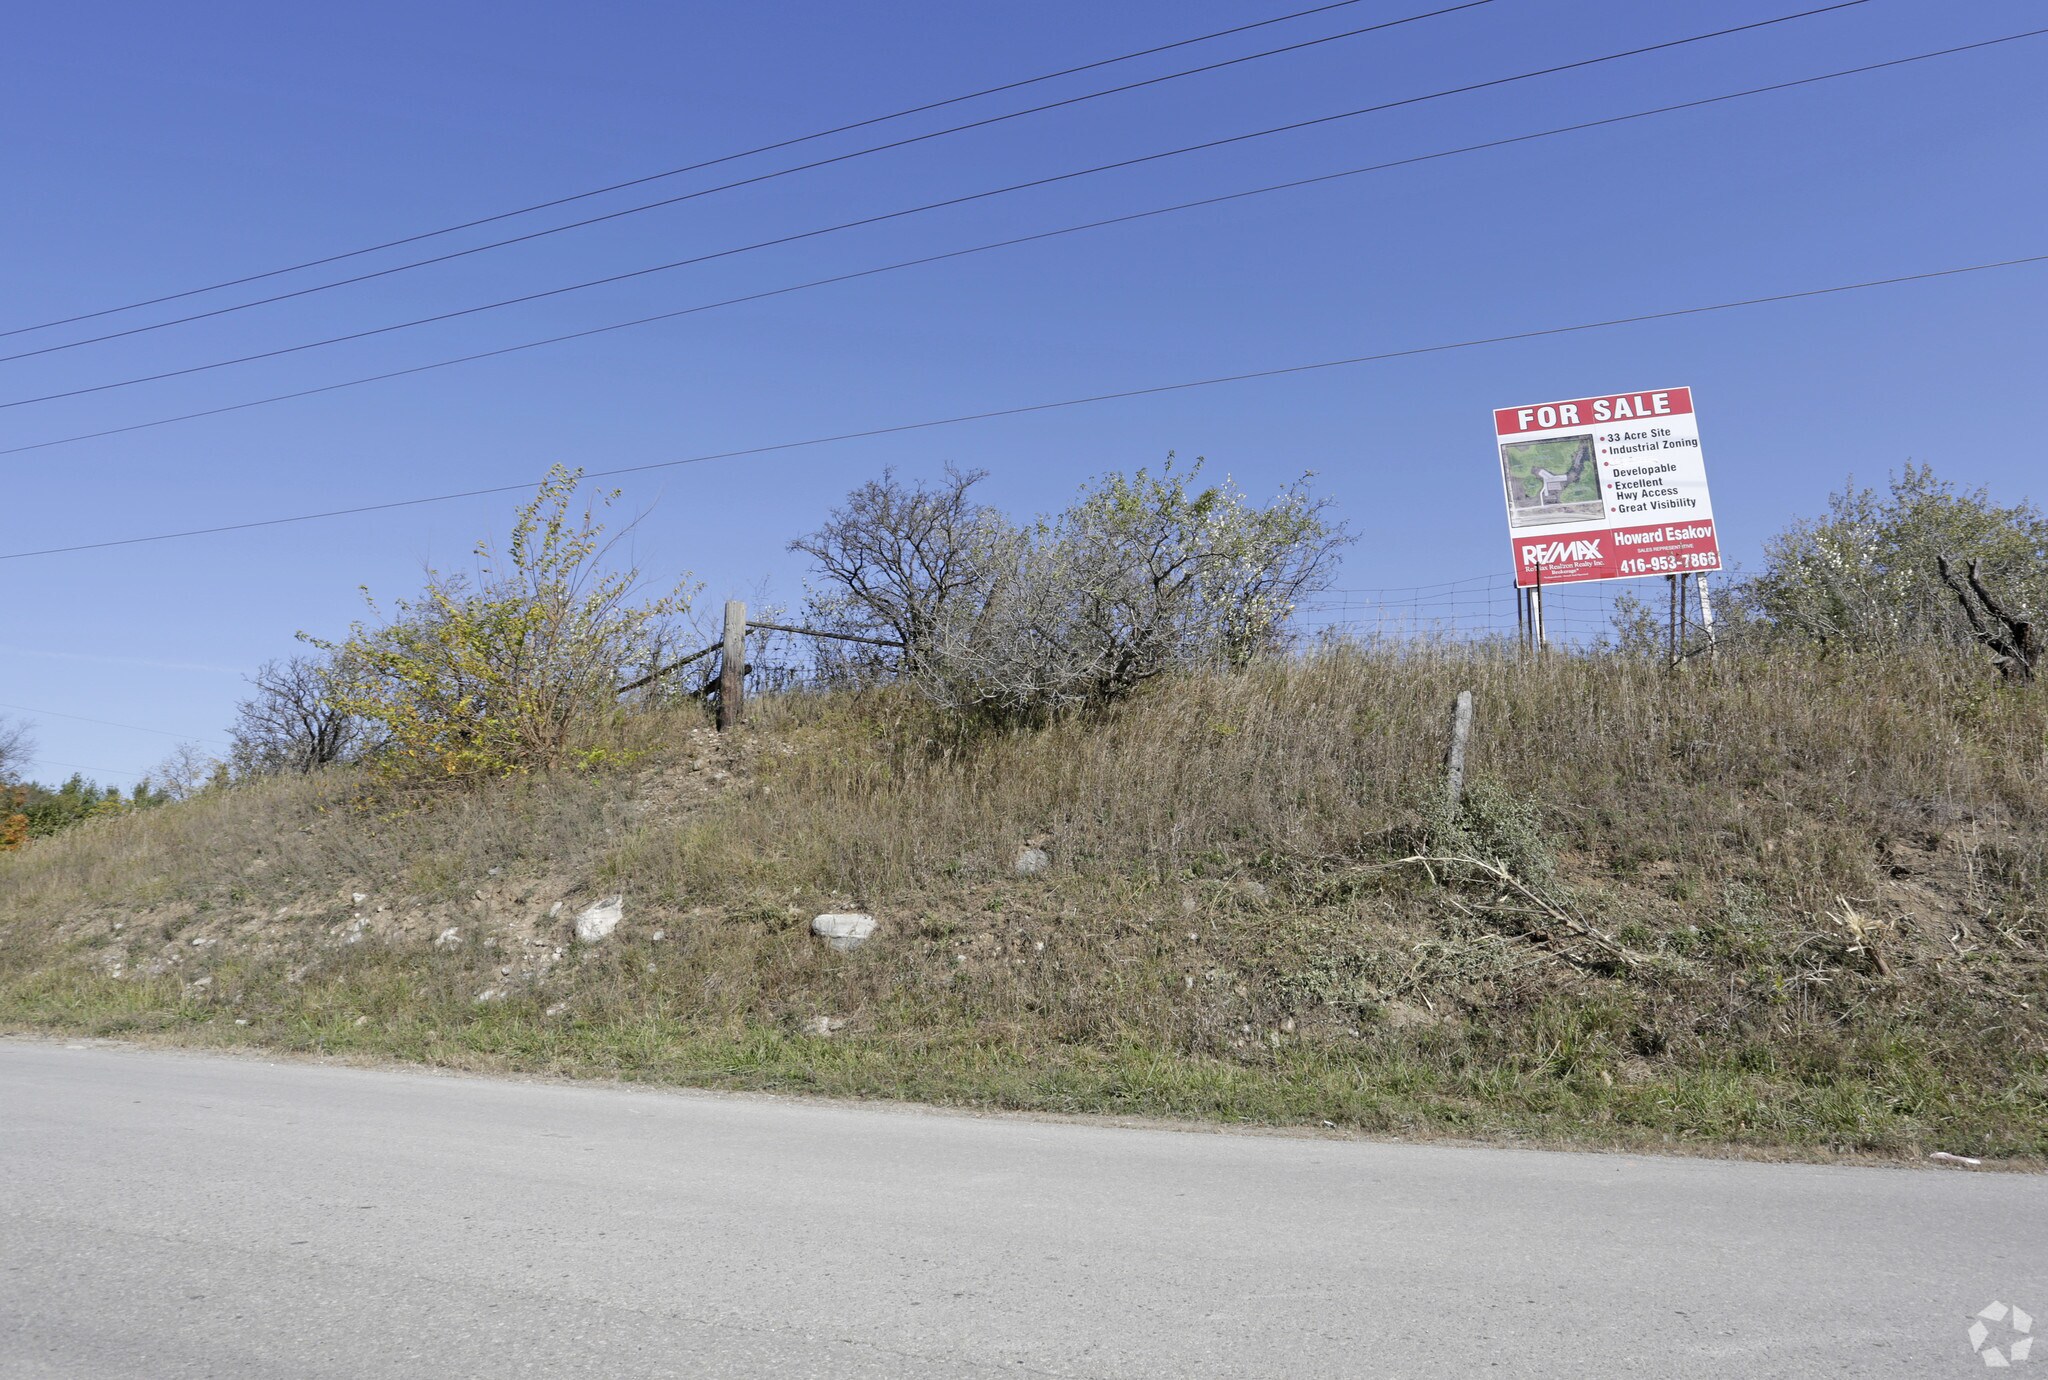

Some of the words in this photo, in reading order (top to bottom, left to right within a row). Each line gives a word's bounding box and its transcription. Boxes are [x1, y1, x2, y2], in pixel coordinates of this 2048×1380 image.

[1518, 404, 1581, 430] FOR
[1593, 392, 1671, 421] SALE
[1607, 433, 1620, 442] 33
[1624, 431, 1647, 441] Acre
[1651, 428, 1671, 437] Site
[1609, 441, 1659, 455] Industrial
[1662, 438, 1698, 449] Zoning
[1613, 463, 1677, 477] Developable
[1615, 477, 1663, 490] Excellent
[1616, 490, 1638, 500] Hwy
[1641, 487, 1679, 498] Access
[1618, 502, 1647, 513] Great
[1650, 498, 1697, 511] Visibility
[1614, 528, 1663, 546] Howard
[1665, 525, 1712, 541] Esakov
[1521, 539, 1604, 566] RE/MAX
[1574, 560, 1593, 569] Realty
[1620, 551, 1717, 574] 416-953-7866
